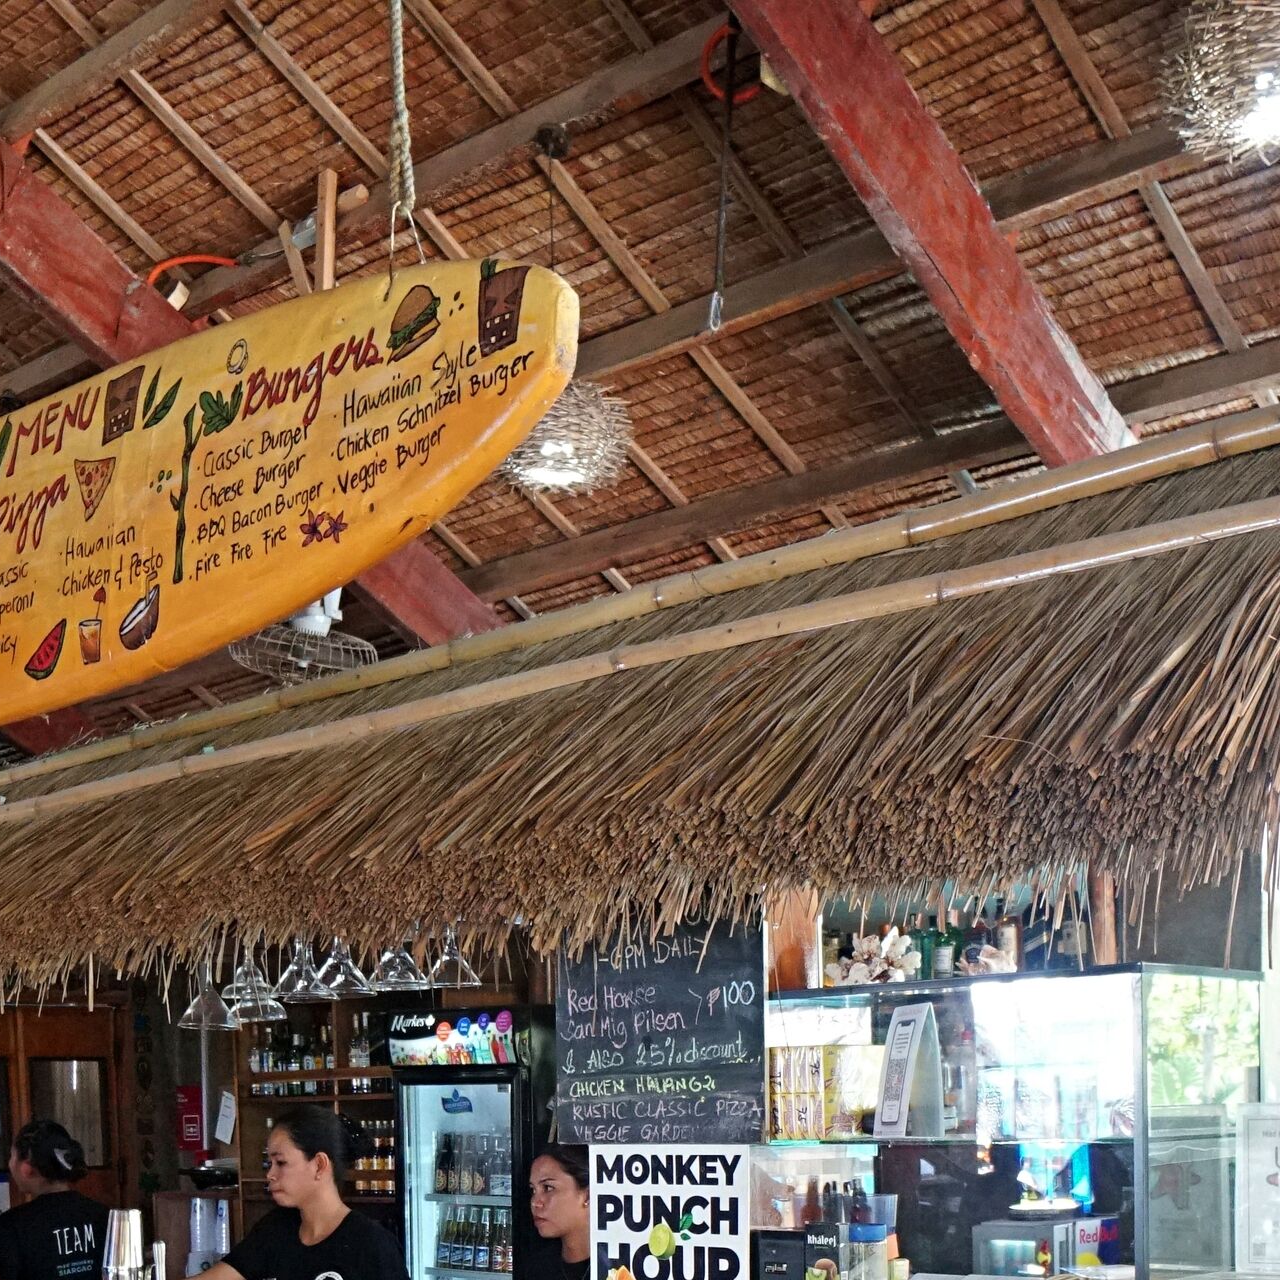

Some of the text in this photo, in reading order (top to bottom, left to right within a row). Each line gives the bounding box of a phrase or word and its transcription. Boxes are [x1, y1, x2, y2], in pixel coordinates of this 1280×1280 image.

[242, 328, 384, 425] Burgers
[336, 351, 534, 461] Chicken Schnitzel Burger
[343, 373, 422, 427] Hawaiian
[6, 387, 101, 477] MENU
[203, 424, 311, 477] Classic Burger
[337, 424, 446, 495] Veggie Burger
[200, 454, 306, 511] Cheese Burger
[197, 482, 323, 544] BBQ Bacon Burger
[65, 524, 135, 564] Hawaiian
[196, 525, 287, 581] Fire Fire Fire
[62, 566, 110, 596] Chicken
[129, 547, 163, 581] Pesto
[654, 936, 709, 964] DAILY
[567, 988, 597, 1015] Red
[600, 1015, 628, 1048] Mig
[633, 1009, 686, 1034] Pilsen
[569, 1081, 625, 1098] CHICKEN
[573, 1100, 764, 1120] RUSTIC CLASSIC PIZZA
[595, 1153, 741, 1187] MONKEY
[596, 1195, 740, 1237] PUNCH
[1079, 1226, 1099, 1244] Red
[53, 1224, 95, 1255] TEAM
[807, 1234, 836, 1248] khaleej
[58, 1265, 93, 1277] SIARGAO
